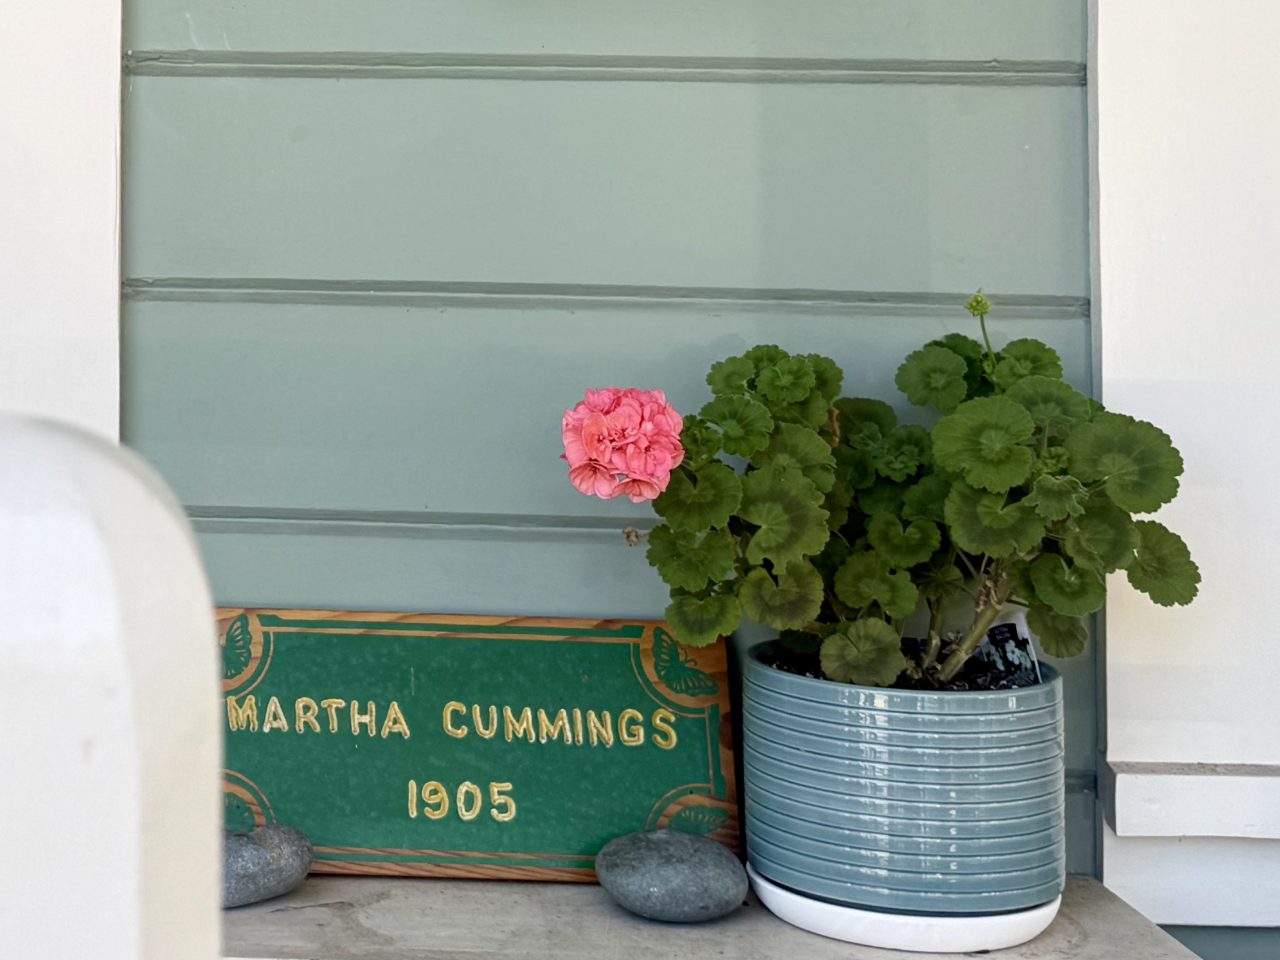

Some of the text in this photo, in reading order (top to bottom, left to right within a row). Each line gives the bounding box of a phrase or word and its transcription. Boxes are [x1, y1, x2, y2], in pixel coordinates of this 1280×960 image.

[226, 695, 678, 750] MARTHA CUMMINGS
[407, 779, 517, 822] 1905
